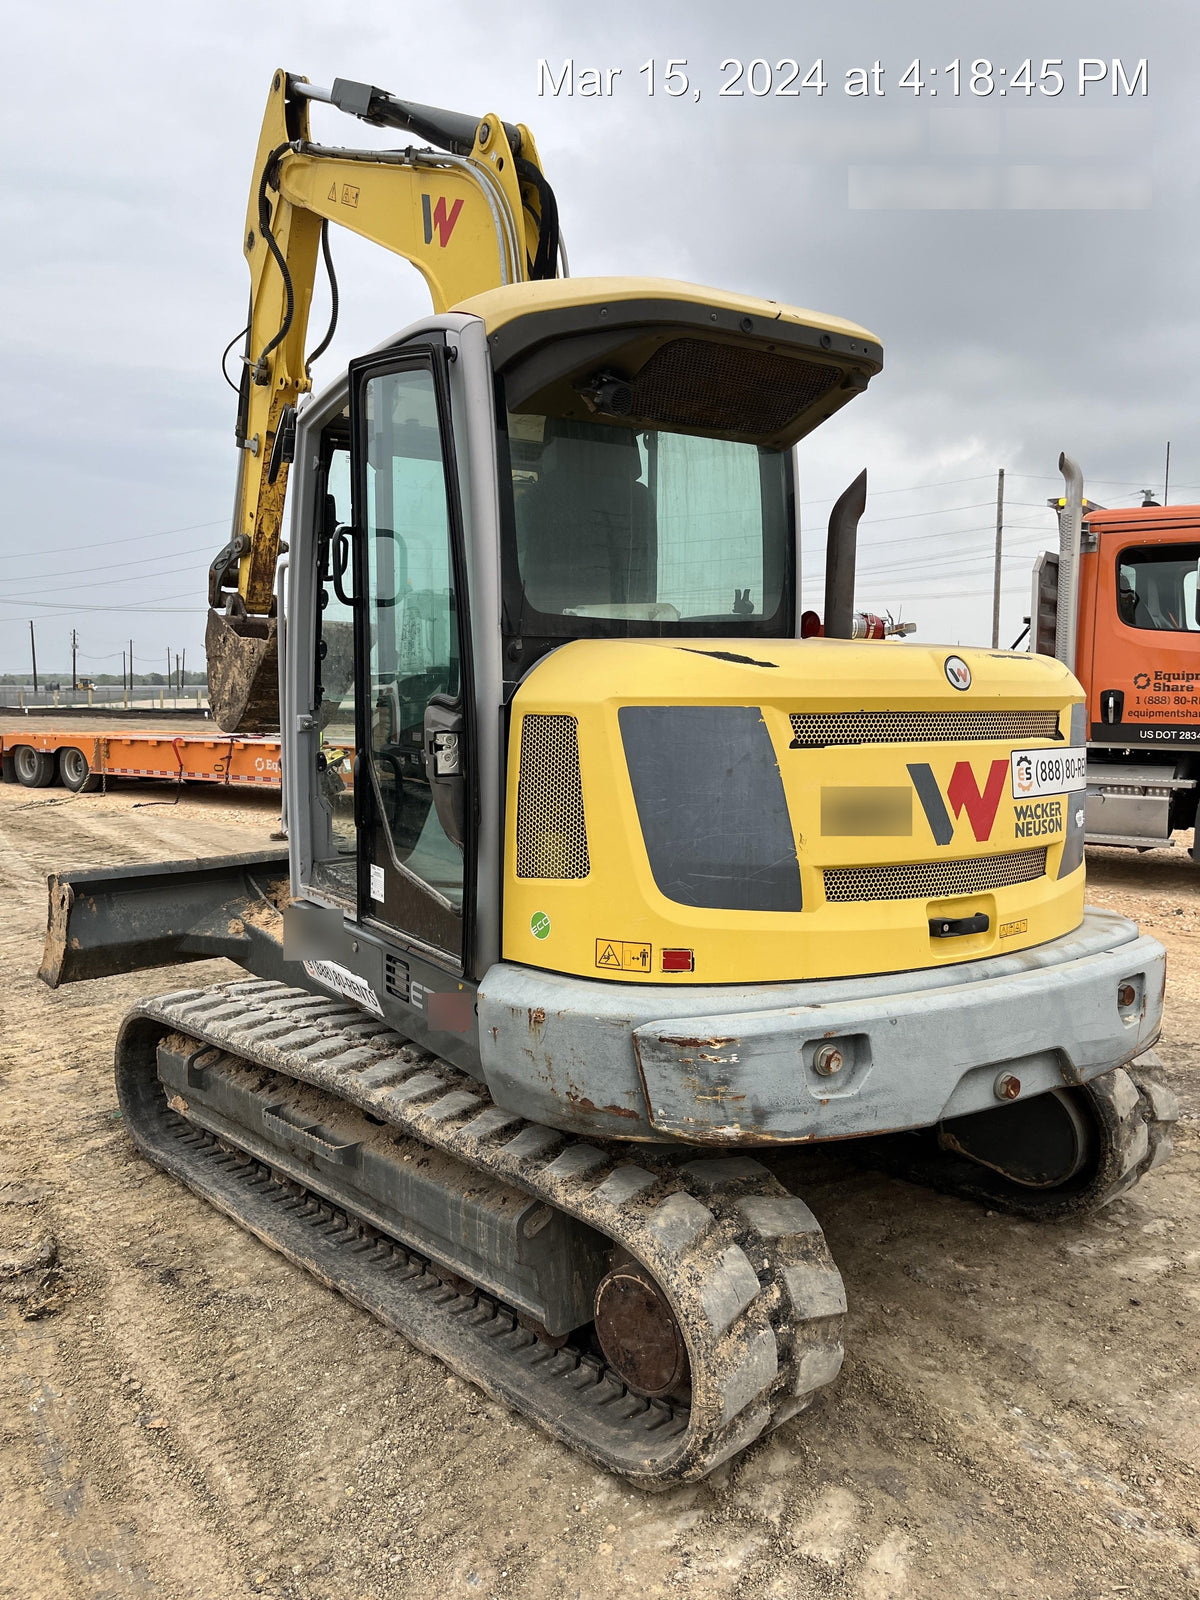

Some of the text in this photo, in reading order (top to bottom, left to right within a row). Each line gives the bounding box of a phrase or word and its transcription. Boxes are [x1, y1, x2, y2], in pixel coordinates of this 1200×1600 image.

[1153, 682, 1194, 692] Share
[1144, 696, 1171, 705] (888)
[1140, 730, 1154, 739] US
[1155, 731, 1178, 739] DOT
[1013, 801, 1062, 822] WACKER
[1014, 817, 1063, 838] NEUSON
[531, 915, 550, 936] ECO
